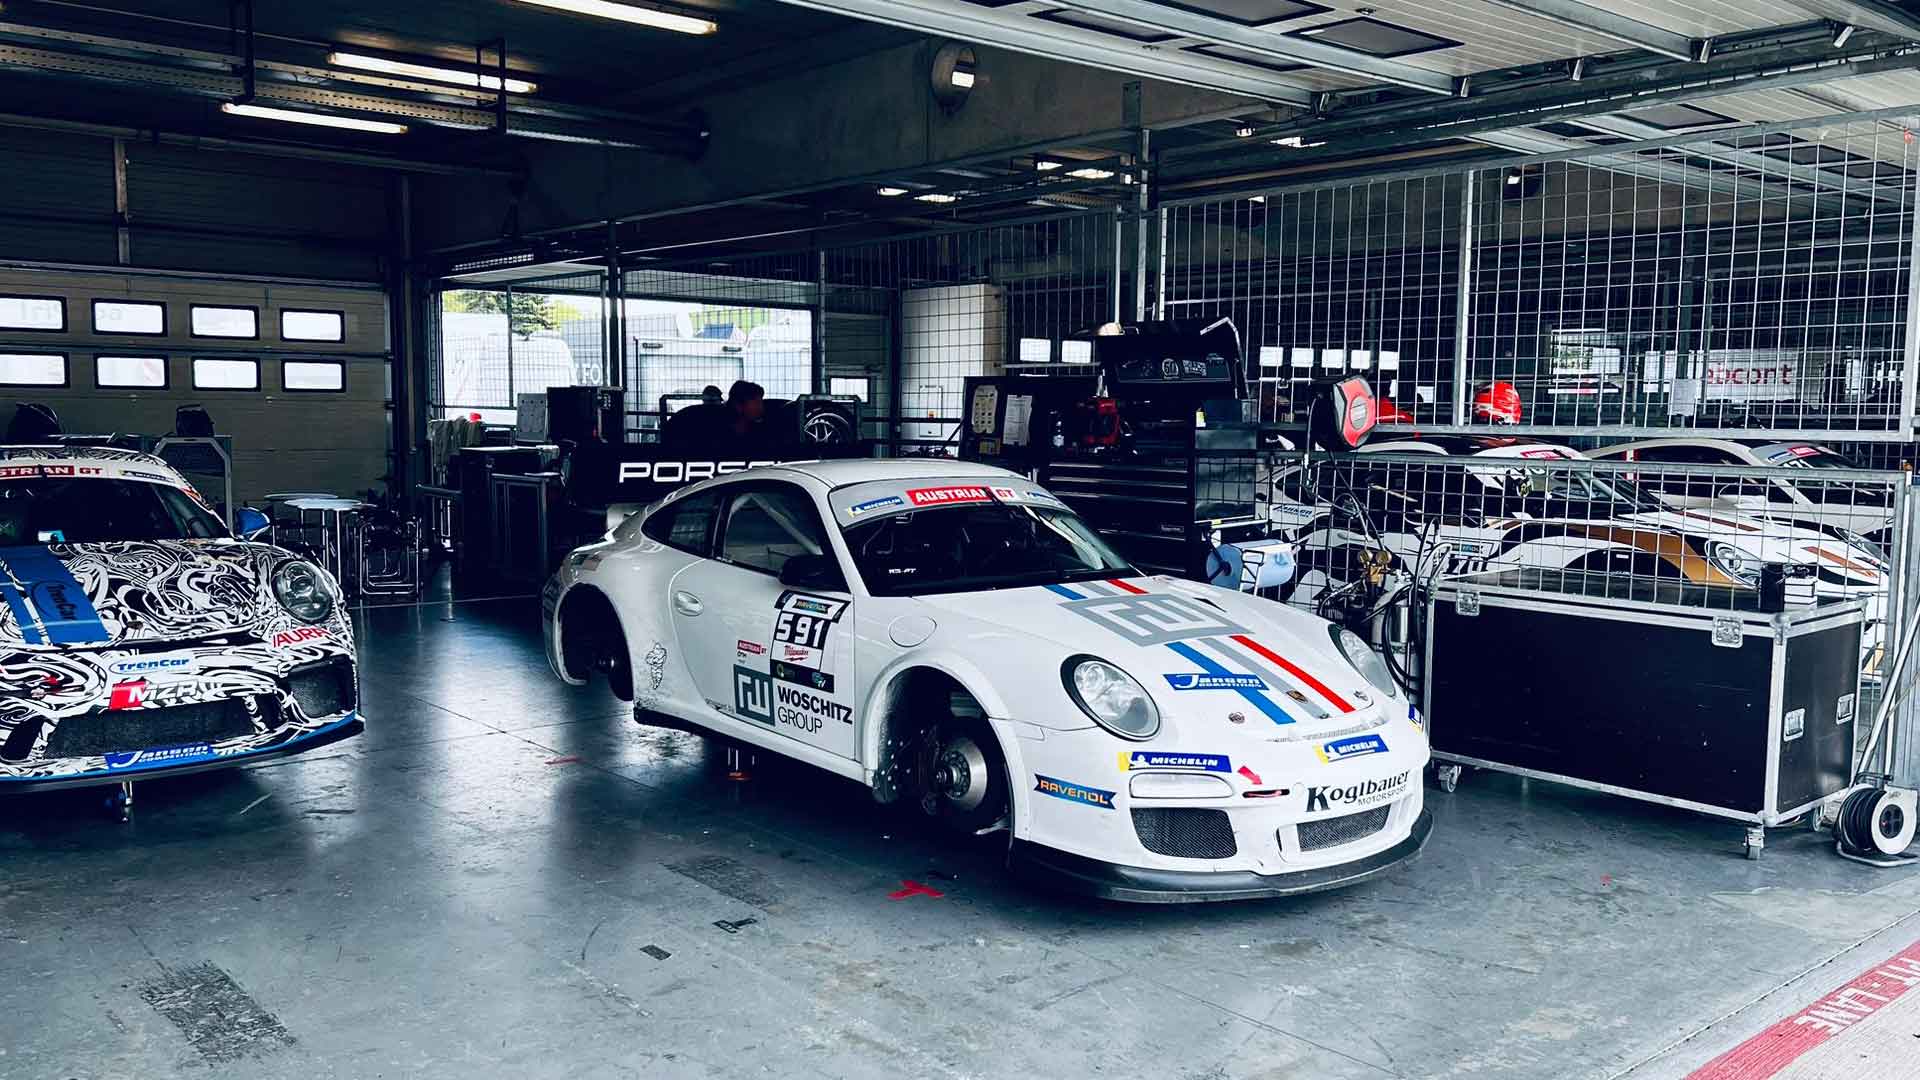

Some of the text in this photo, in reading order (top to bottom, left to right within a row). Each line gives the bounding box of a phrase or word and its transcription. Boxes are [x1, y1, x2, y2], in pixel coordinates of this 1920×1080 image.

[619, 462, 782, 483] PORS
[776, 613, 825, 648] 591
[777, 685, 853, 725] WOSCHITZ
[777, 707, 823, 734] GROUP
[1338, 740, 1379, 754] MICHELIN
[1150, 757, 1218, 767] MICHELIN
[1305, 770, 1410, 813] Koglbauer
